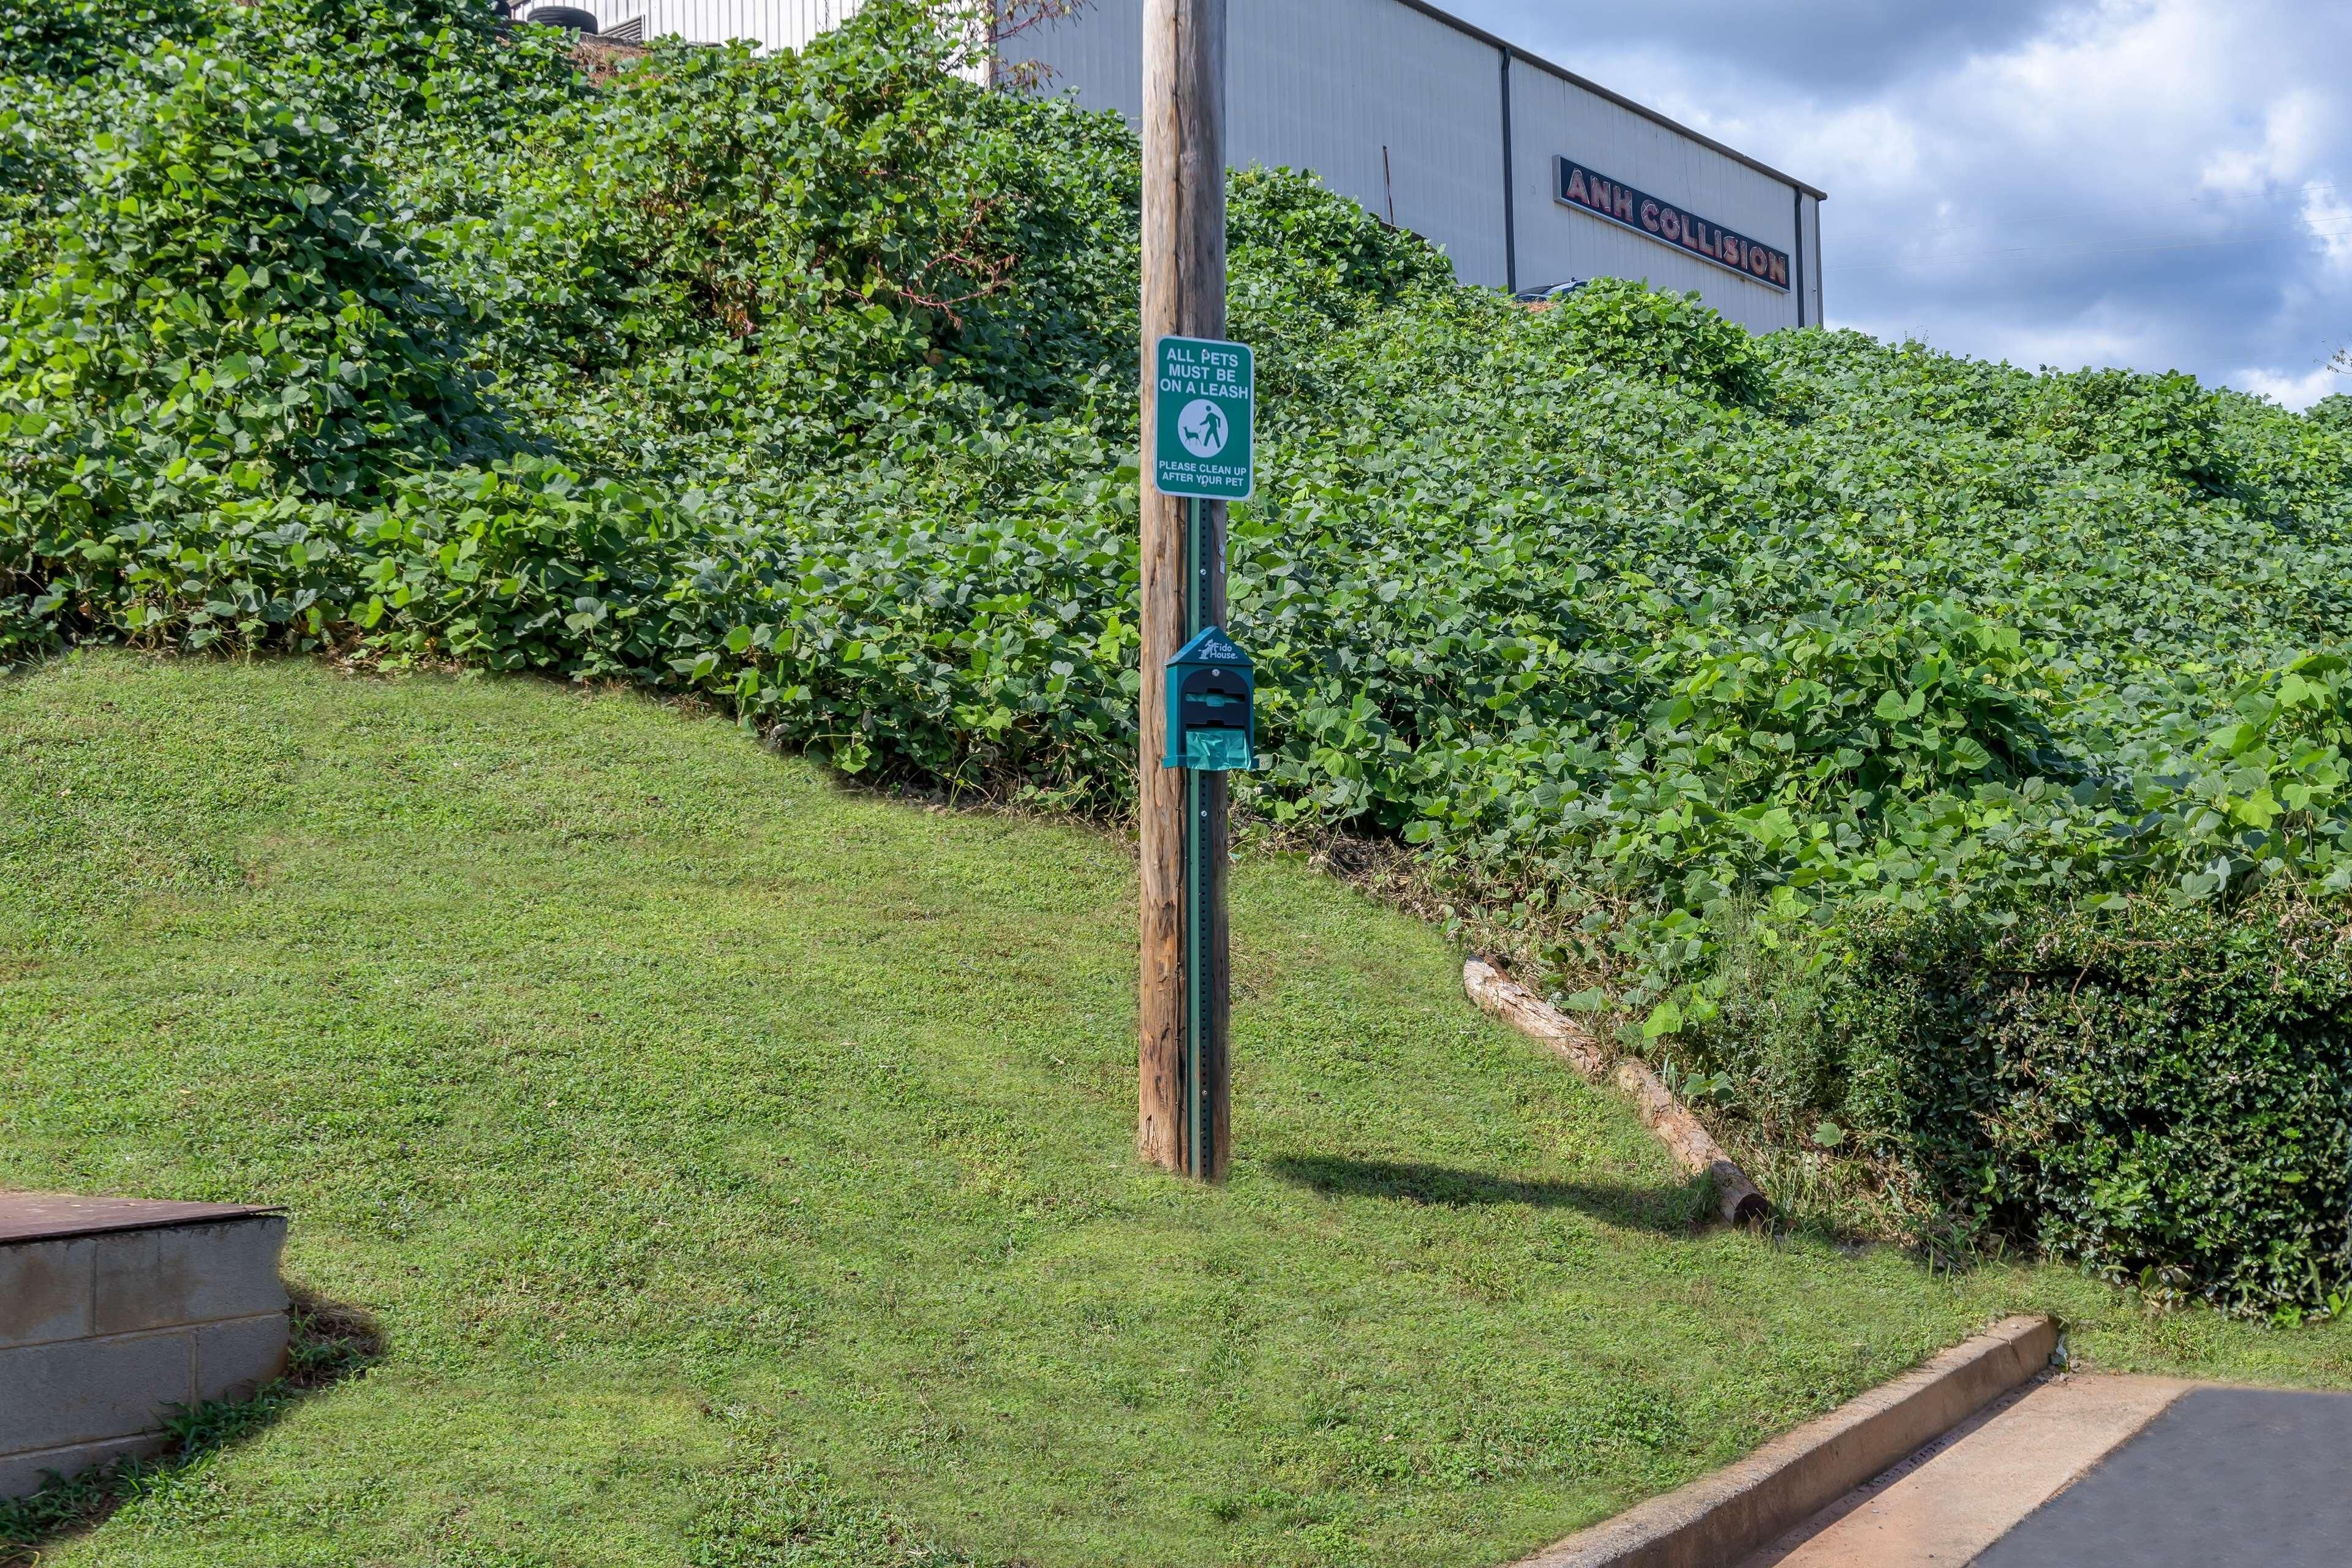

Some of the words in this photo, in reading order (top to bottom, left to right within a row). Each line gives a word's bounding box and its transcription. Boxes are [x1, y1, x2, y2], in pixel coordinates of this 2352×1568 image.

[1566, 168, 1634, 222] ANH
[1641, 200, 1786, 284] COLLISION
[1166, 348, 1194, 363] ALL
[1201, 351, 1238, 367] PETS
[1169, 364, 1210, 380] MUST
[1216, 369, 1235, 382] BE
[1160, 379, 1182, 393] ON
[1186, 381, 1196, 394] A
[1200, 383, 1248, 399] LEASH
[1159, 461, 1196, 472] PLEASE
[1199, 464, 1232, 475] CLEAN
[1234, 467, 1246, 476] UP
[1162, 472, 1193, 482] AFTER
[1196, 474, 1223, 486] YOUR
[1226, 477, 1243, 486] PET
[1214, 643, 1232, 652] Fido
